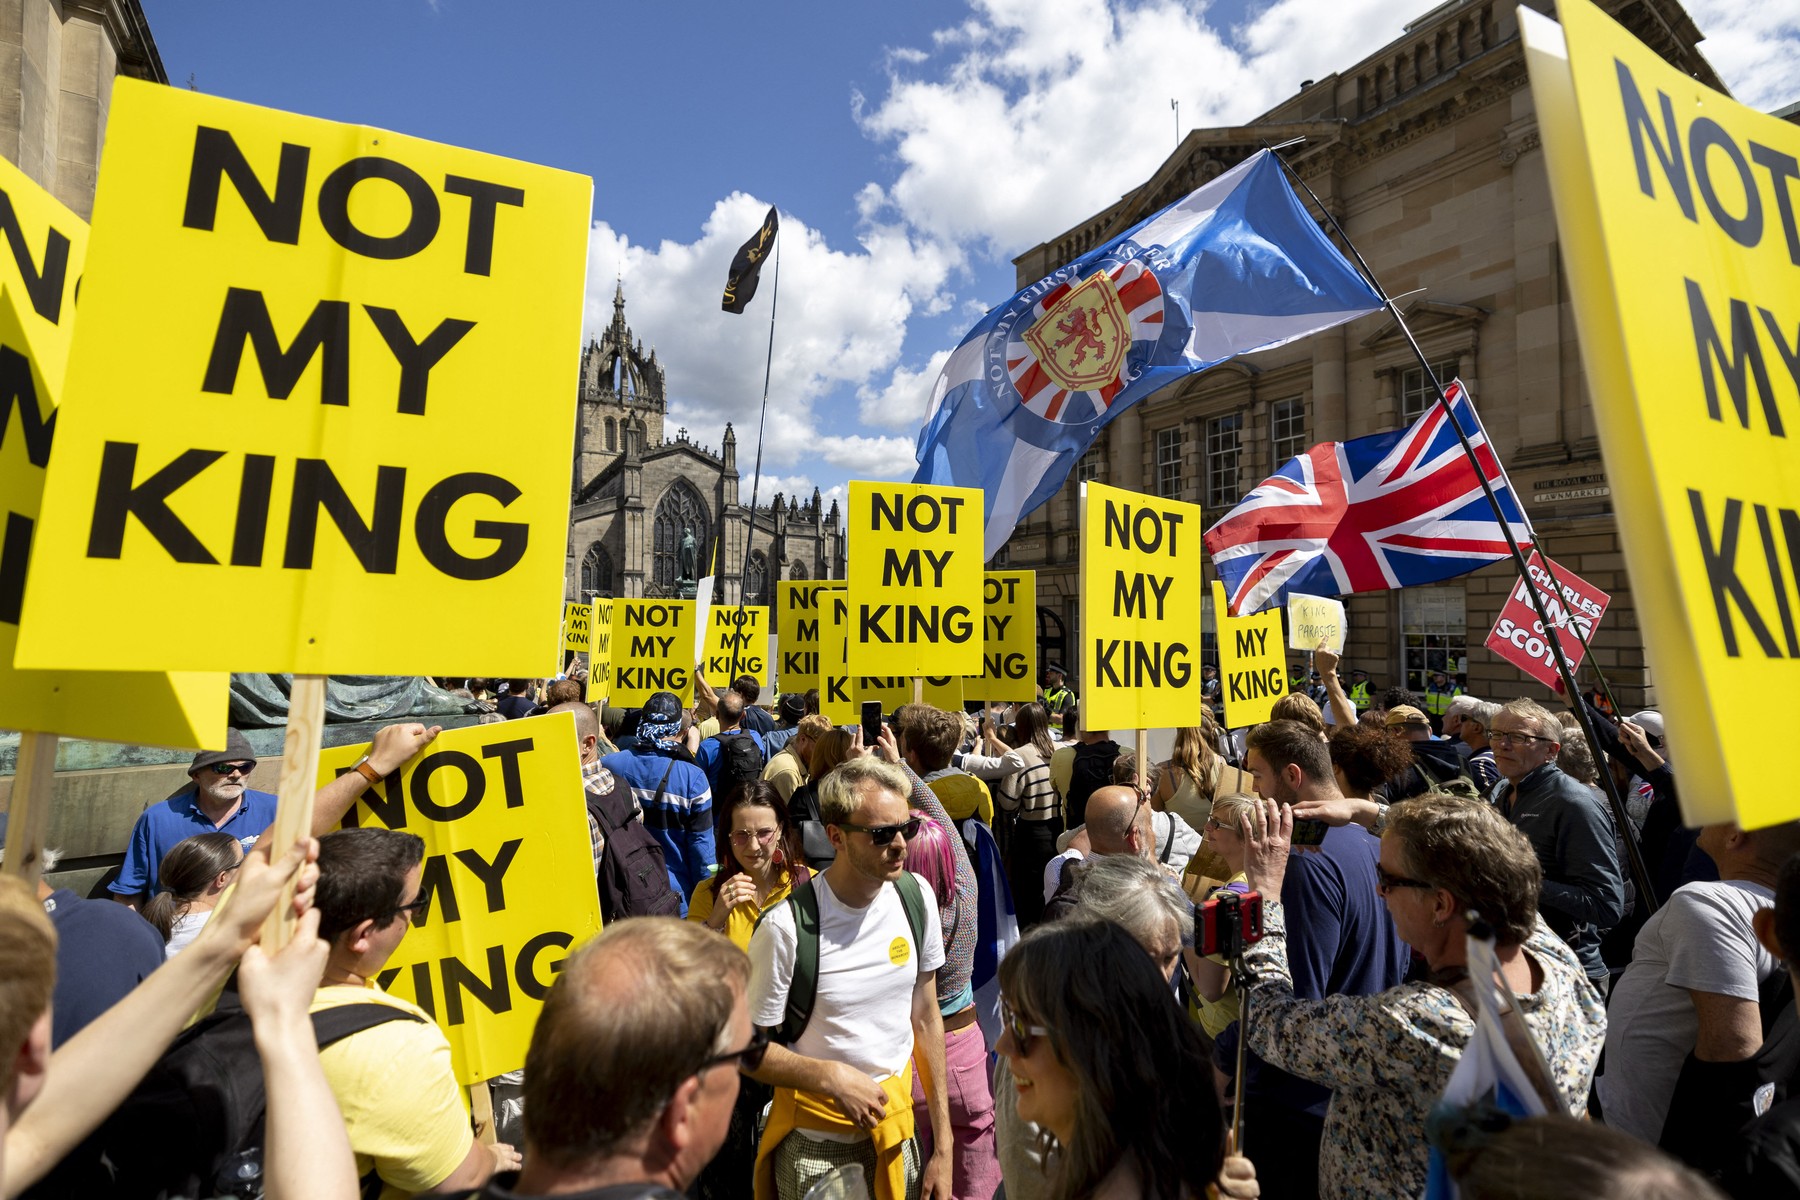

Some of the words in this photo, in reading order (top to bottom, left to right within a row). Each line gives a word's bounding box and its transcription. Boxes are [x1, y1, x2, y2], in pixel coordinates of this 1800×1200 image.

[182, 125, 525, 278] NOT
[1018, 263, 1083, 305] FIRST
[994, 307, 1018, 341] MY
[200, 286, 479, 416] MY
[990, 348, 1011, 399] NOT
[86, 440, 530, 581] KING
[1539, 488, 1605, 501] LAWNMARKET
[871, 492, 965, 534] NOT
[1105, 499, 1184, 557] NOT
[881, 548, 955, 588] MY
[1687, 488, 1800, 659] KI
[984, 578, 1020, 605] OT
[1113, 569, 1174, 620] MY
[1527, 564, 1602, 618] CHARLES
[571, 606, 592, 617] NO
[625, 604, 684, 627] NOT
[716, 609, 760, 627] NOT
[859, 604, 974, 644] KING
[984, 615, 1012, 641] Y
[630, 636, 676, 658] MY
[720, 633, 754, 650] MY
[796, 619, 818, 641] M
[1235, 628, 1268, 658] MY
[1298, 624, 1336, 638] PARASITE
[616, 667, 688, 690] KING
[709, 656, 763, 673] KING
[785, 652, 818, 674] KI
[962, 652, 1028, 679] NG
[1096, 638, 1191, 689] KING
[1228, 667, 1283, 702] KING
[335, 737, 535, 830] NOT
